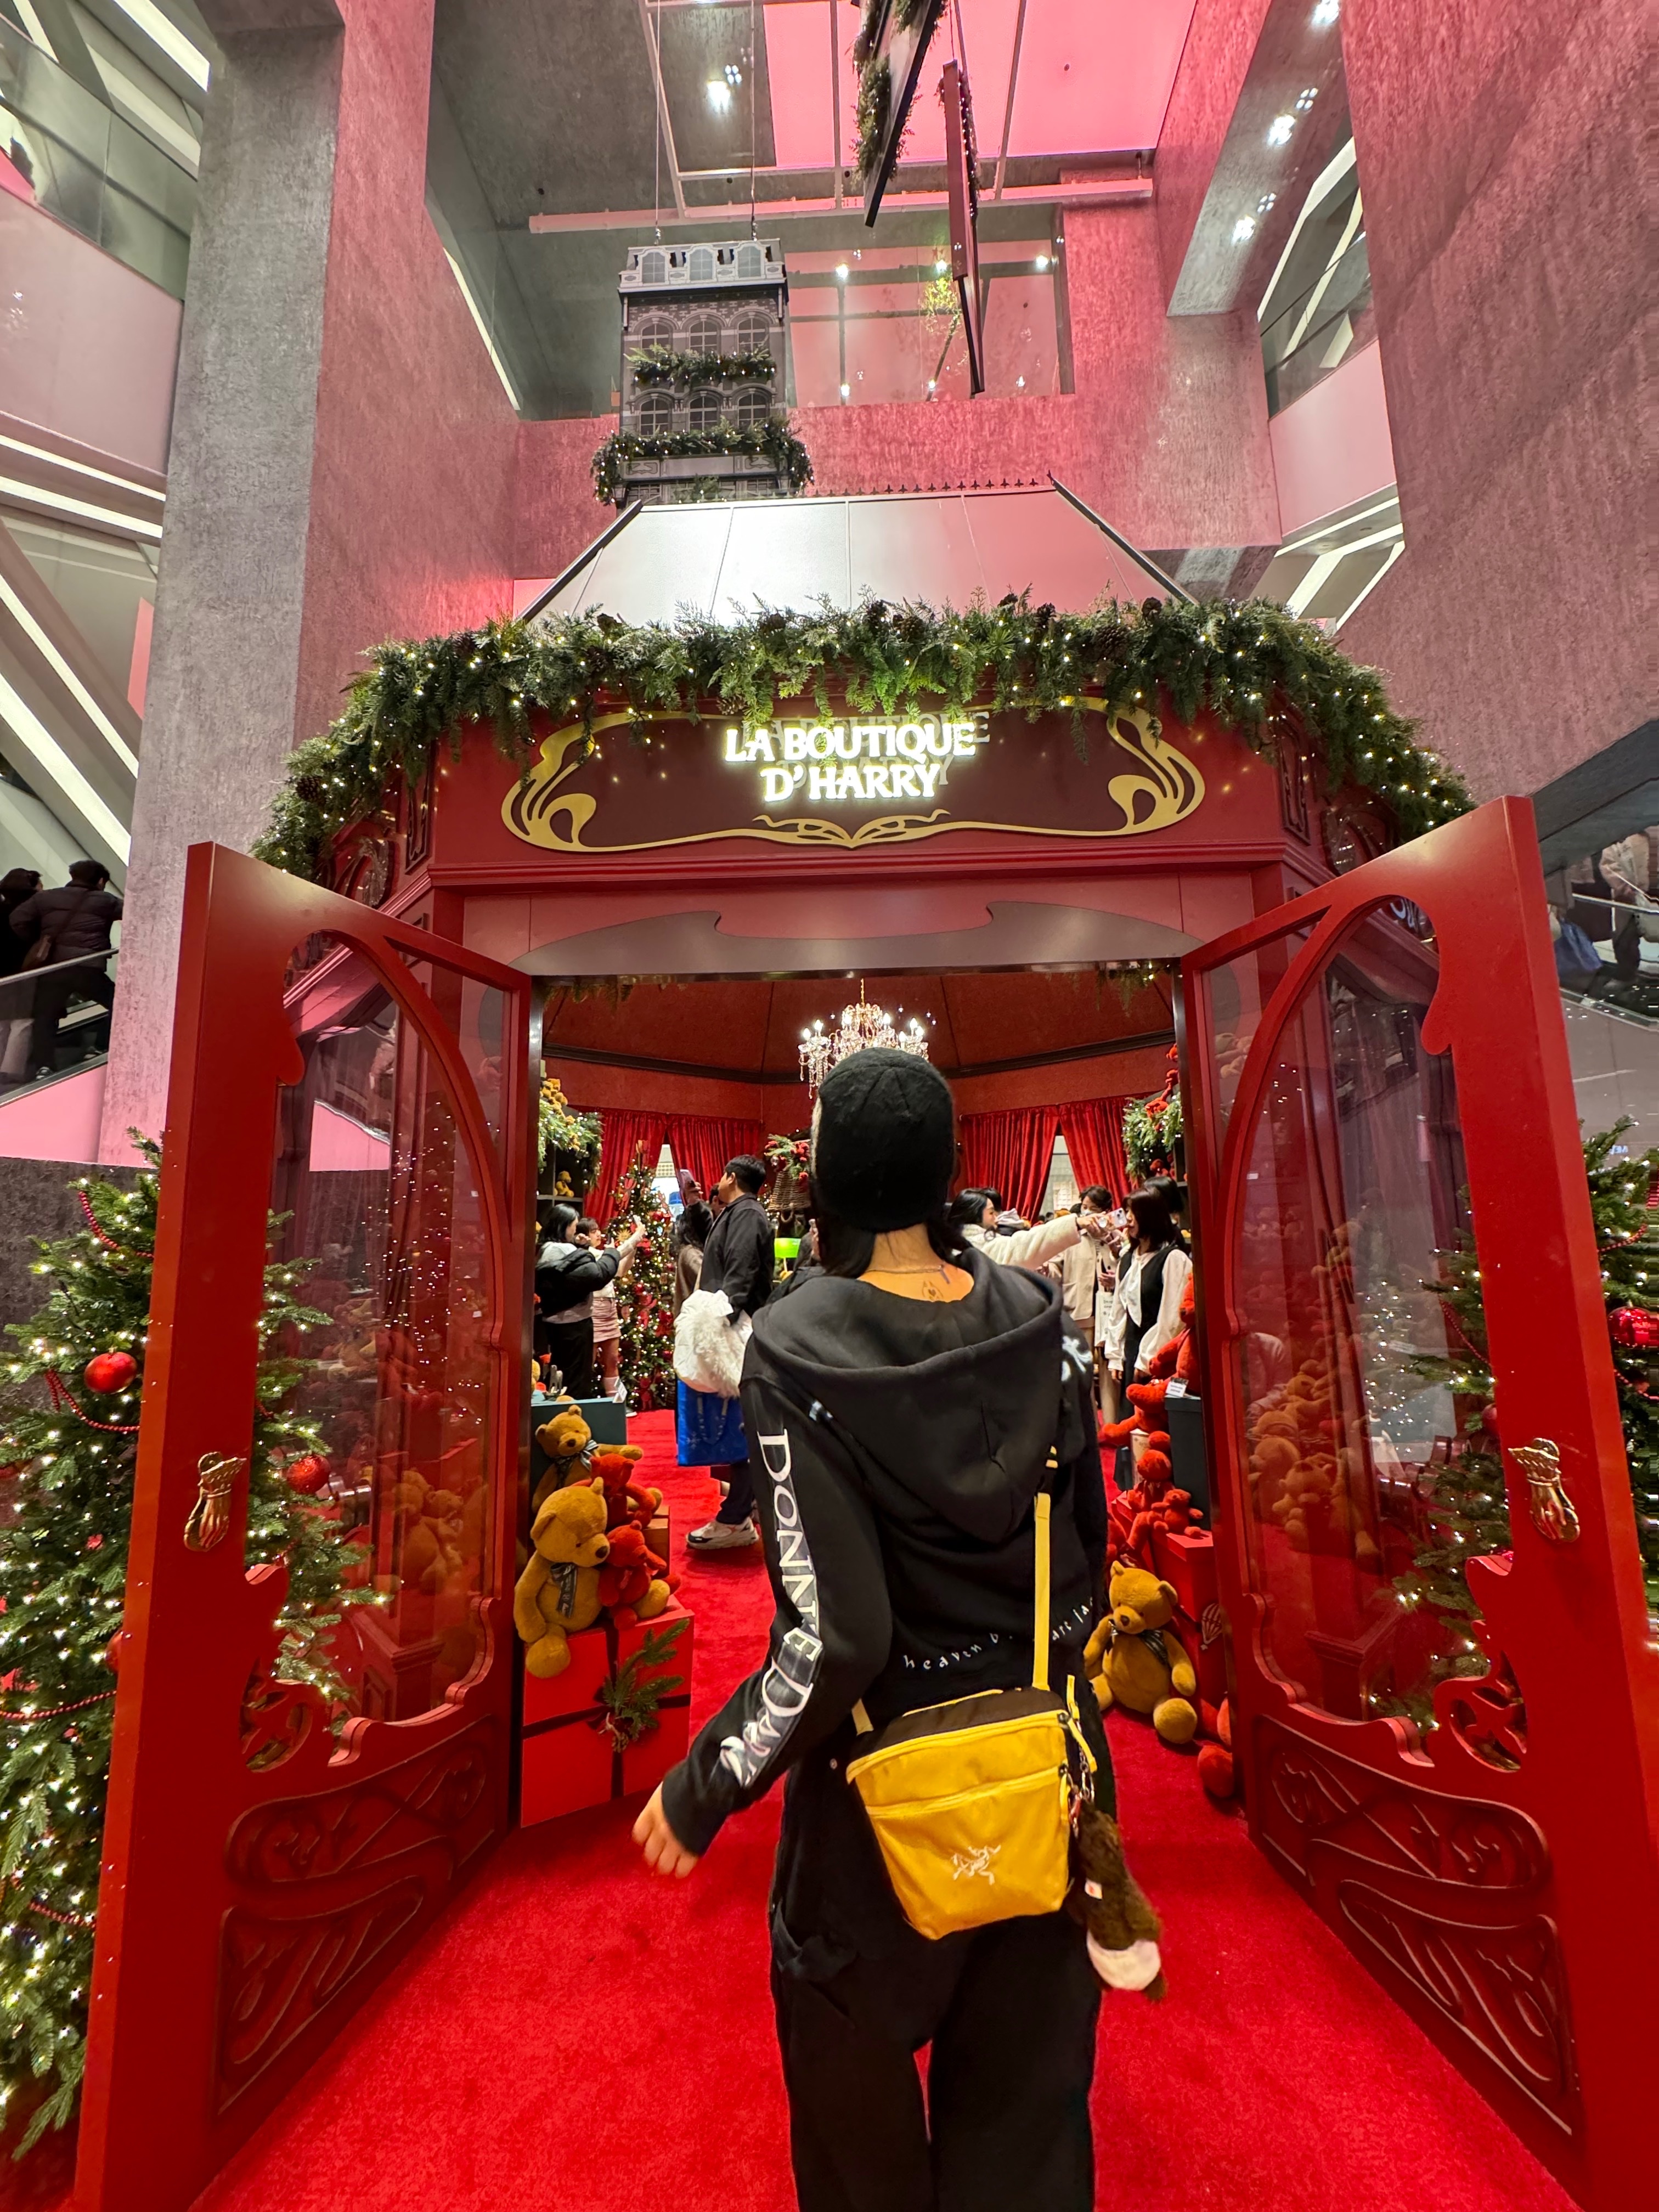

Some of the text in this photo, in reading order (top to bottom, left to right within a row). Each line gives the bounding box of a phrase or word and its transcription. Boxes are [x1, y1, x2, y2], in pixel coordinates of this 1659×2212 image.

[725, 721, 976, 764] LA BOUTIQUE
[760, 763, 941, 802] D'HARRY
[757, 1428, 823, 1661] DONNE
[902, 1643, 983, 1671] heaven
